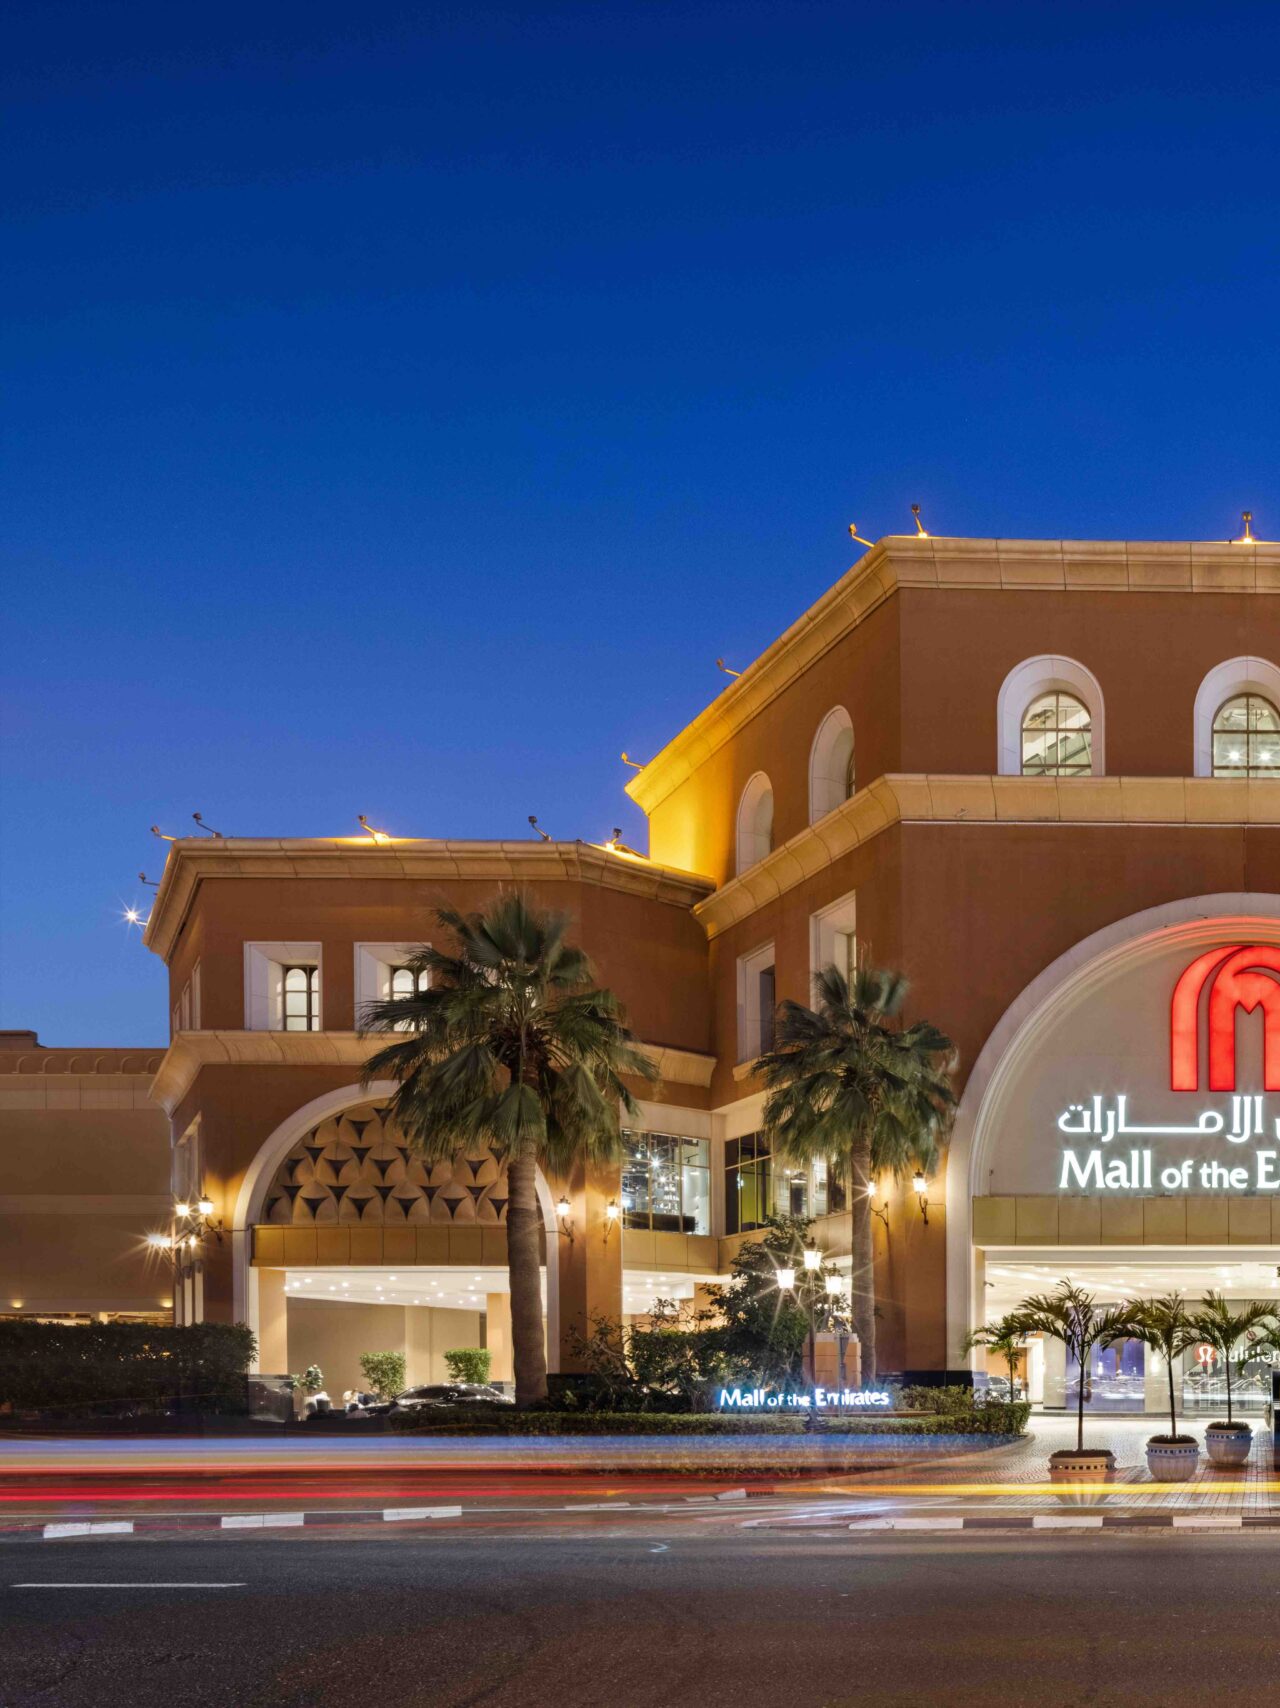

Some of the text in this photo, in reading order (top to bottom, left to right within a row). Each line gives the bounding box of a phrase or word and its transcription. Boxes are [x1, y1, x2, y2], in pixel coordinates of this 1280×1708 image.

[1058, 1149, 1153, 1189] Mall
[1160, 1160, 1195, 1189] of
[1198, 1161, 1249, 1189] the
[720, 1388, 890, 1407] Mall of the Emirates
